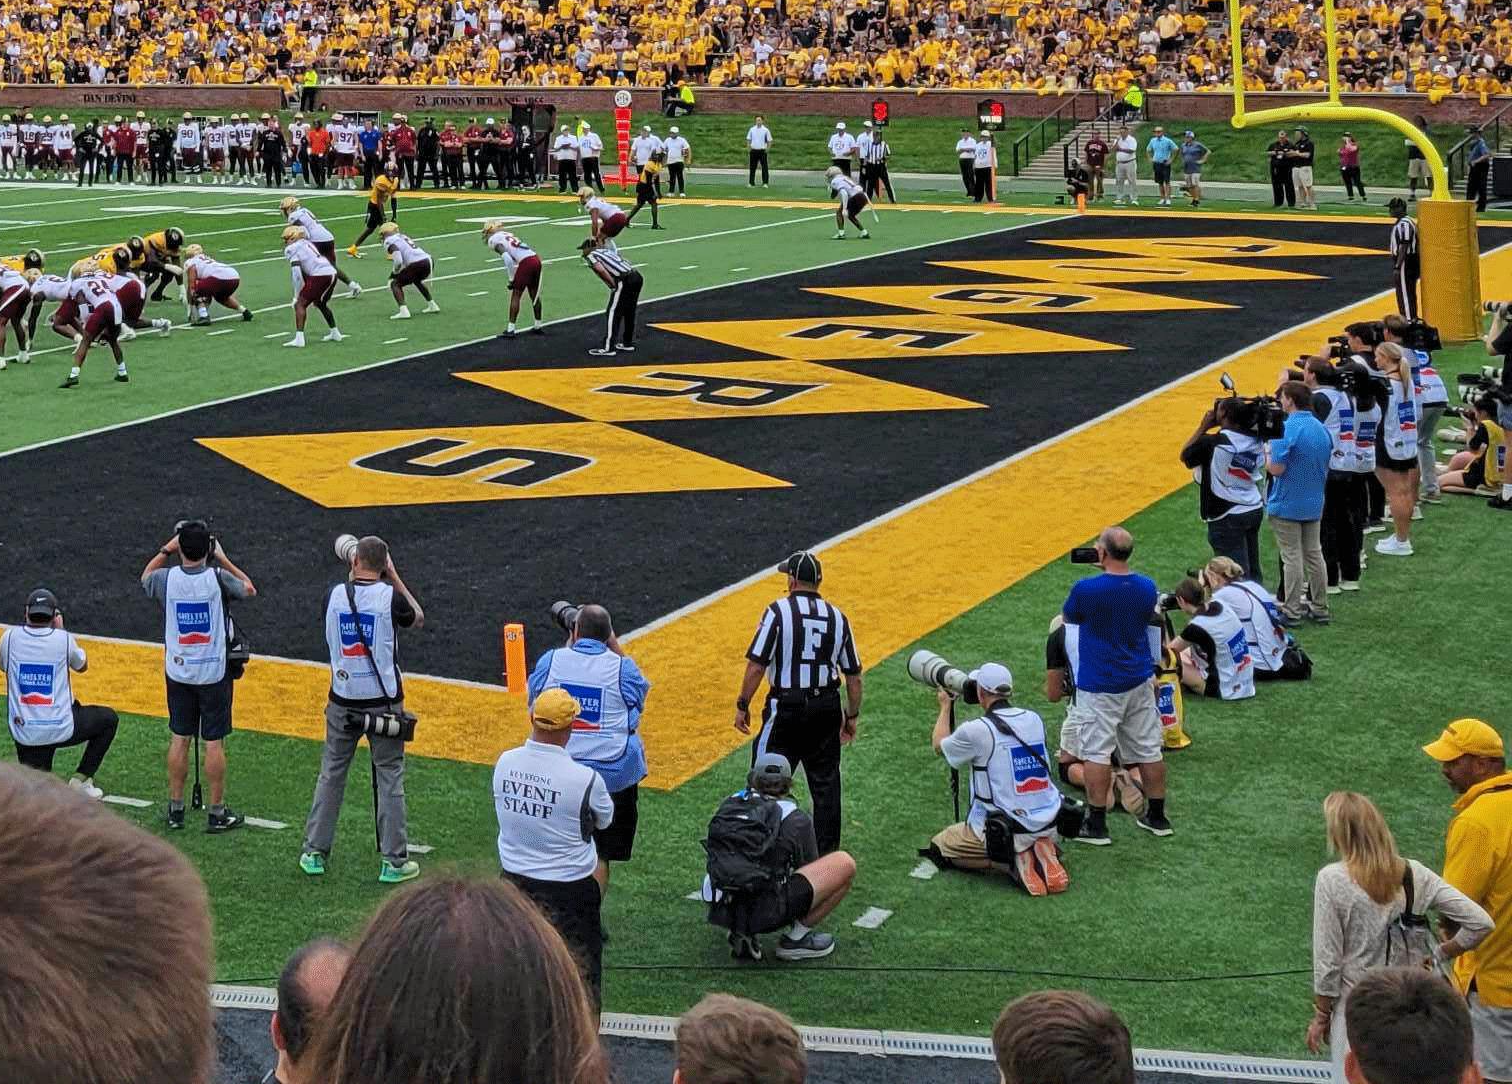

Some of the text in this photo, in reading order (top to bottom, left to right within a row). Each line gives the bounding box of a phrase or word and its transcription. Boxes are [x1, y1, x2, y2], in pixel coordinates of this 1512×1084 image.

[415, 95, 426, 107] 23
[432, 96, 473, 107] JOHNNY
[802, 618, 828, 660] F
[509, 769, 553, 786] KEYSTONE
[502, 779, 561, 805] EVENT
[503, 797, 553, 820] STAFF
